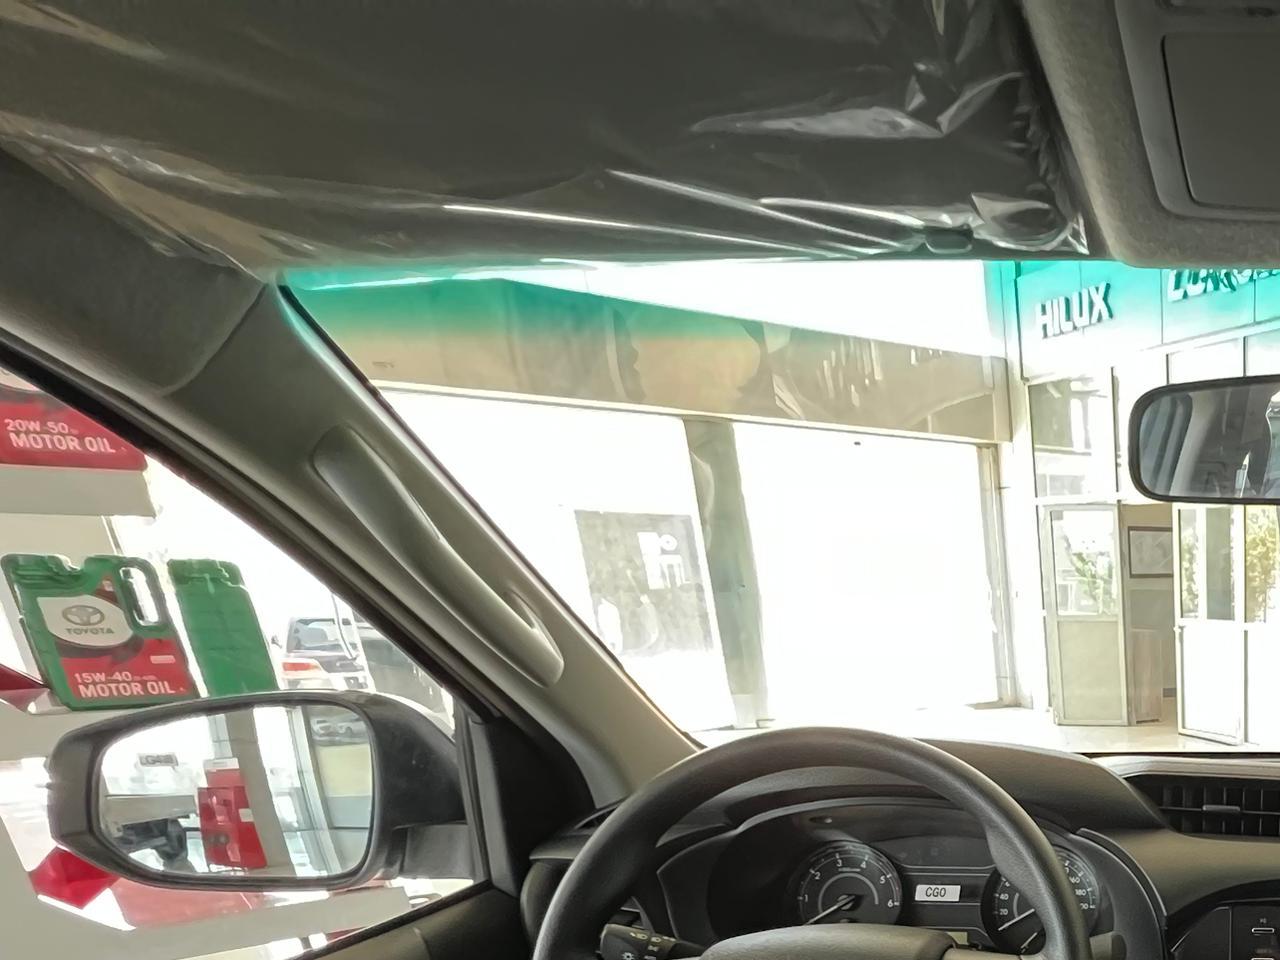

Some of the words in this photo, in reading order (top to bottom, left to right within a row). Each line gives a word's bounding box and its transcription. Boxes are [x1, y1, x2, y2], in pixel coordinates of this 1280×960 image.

[1035, 281, 1112, 338] HILUX
[9, 432, 82, 451] MOTOR
[84, 436, 116, 453] OIL
[65, 627, 115, 635] TOYOTA
[77, 682, 144, 698] MOTOR
[146, 681, 177, 694] OIL
